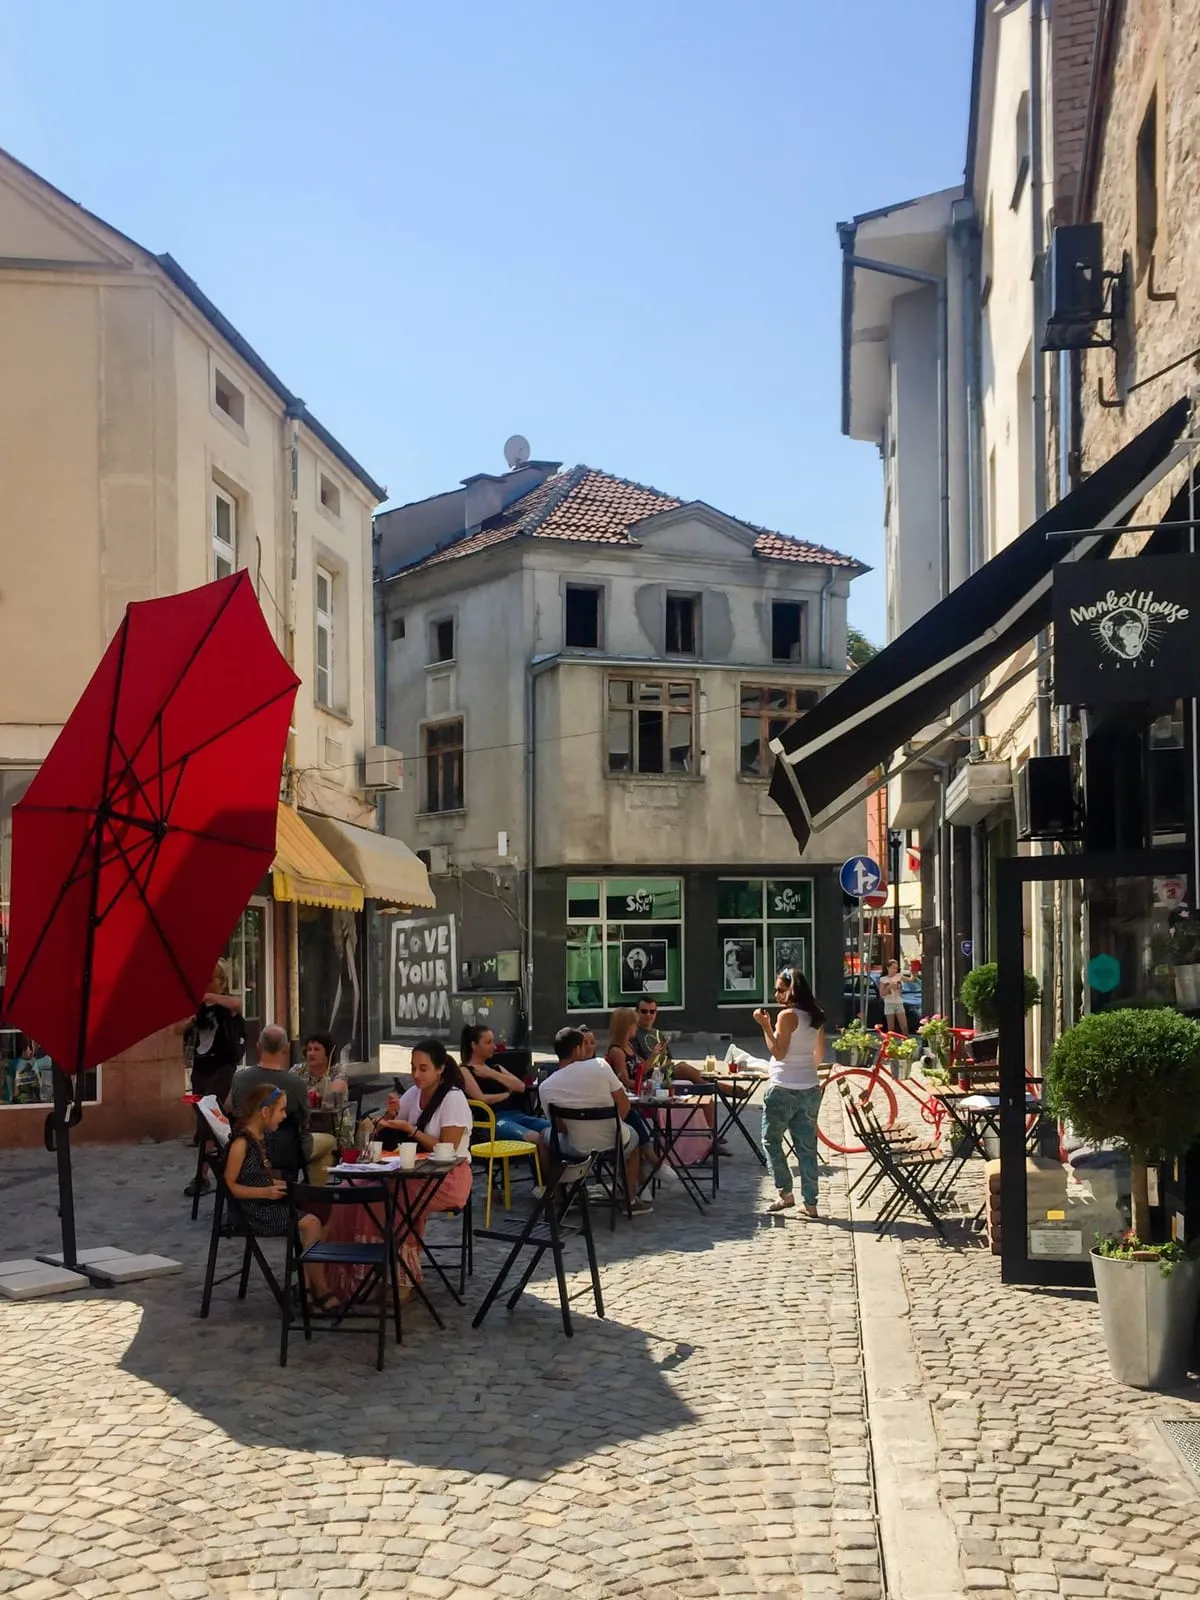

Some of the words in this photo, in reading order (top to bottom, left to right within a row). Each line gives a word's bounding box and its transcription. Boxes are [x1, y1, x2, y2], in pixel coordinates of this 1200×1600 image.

[1137, 591, 1189, 623] House
[399, 925, 450, 958] LOVE
[398, 959, 449, 988] YOUR
[398, 990, 450, 1021] MOM
